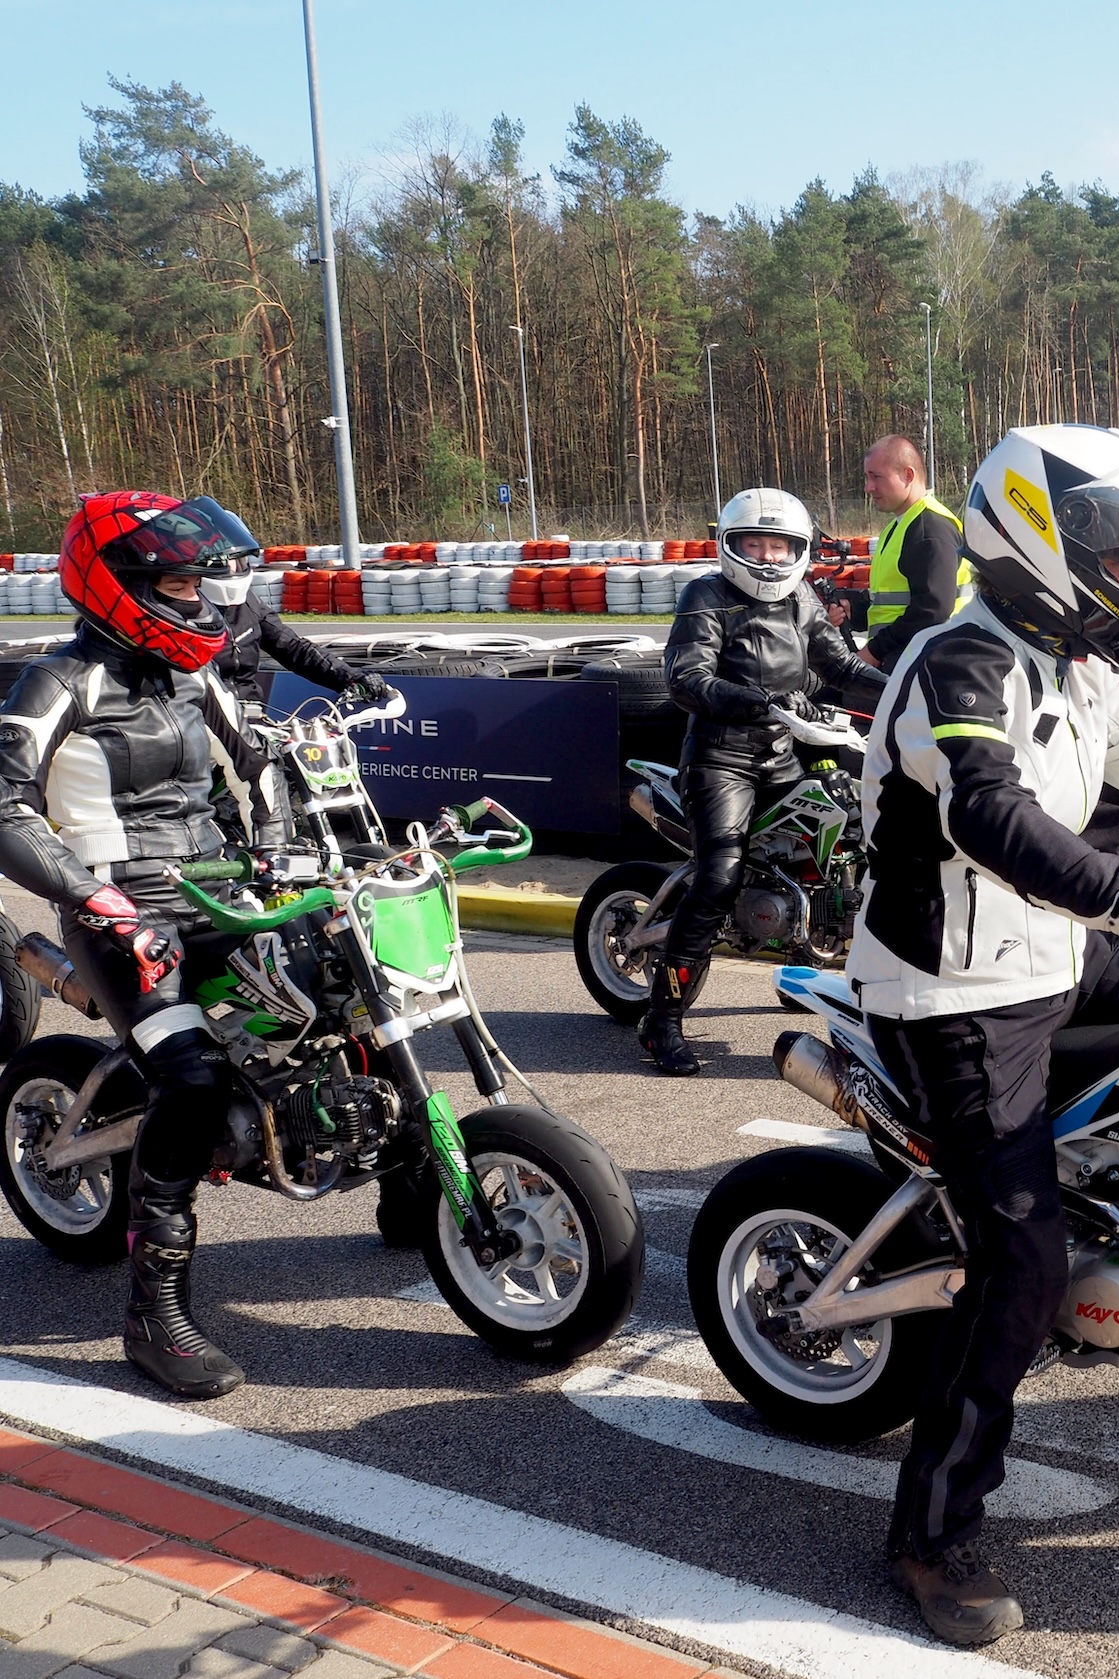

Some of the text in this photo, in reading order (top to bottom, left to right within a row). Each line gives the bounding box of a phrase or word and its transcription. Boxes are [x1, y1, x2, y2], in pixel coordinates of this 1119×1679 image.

[499, 487, 508, 501] P
[1009, 487, 1048, 531] C5
[349, 718, 439, 737] PINE
[303, 747, 322, 762] 10
[422, 766, 478, 782] CENTER
[789, 797, 836, 814] MRF
[235, 981, 308, 1026] MRF
[863, 1103, 904, 1141] TRENER
[868, 1093, 908, 1134] TRACK DAY
